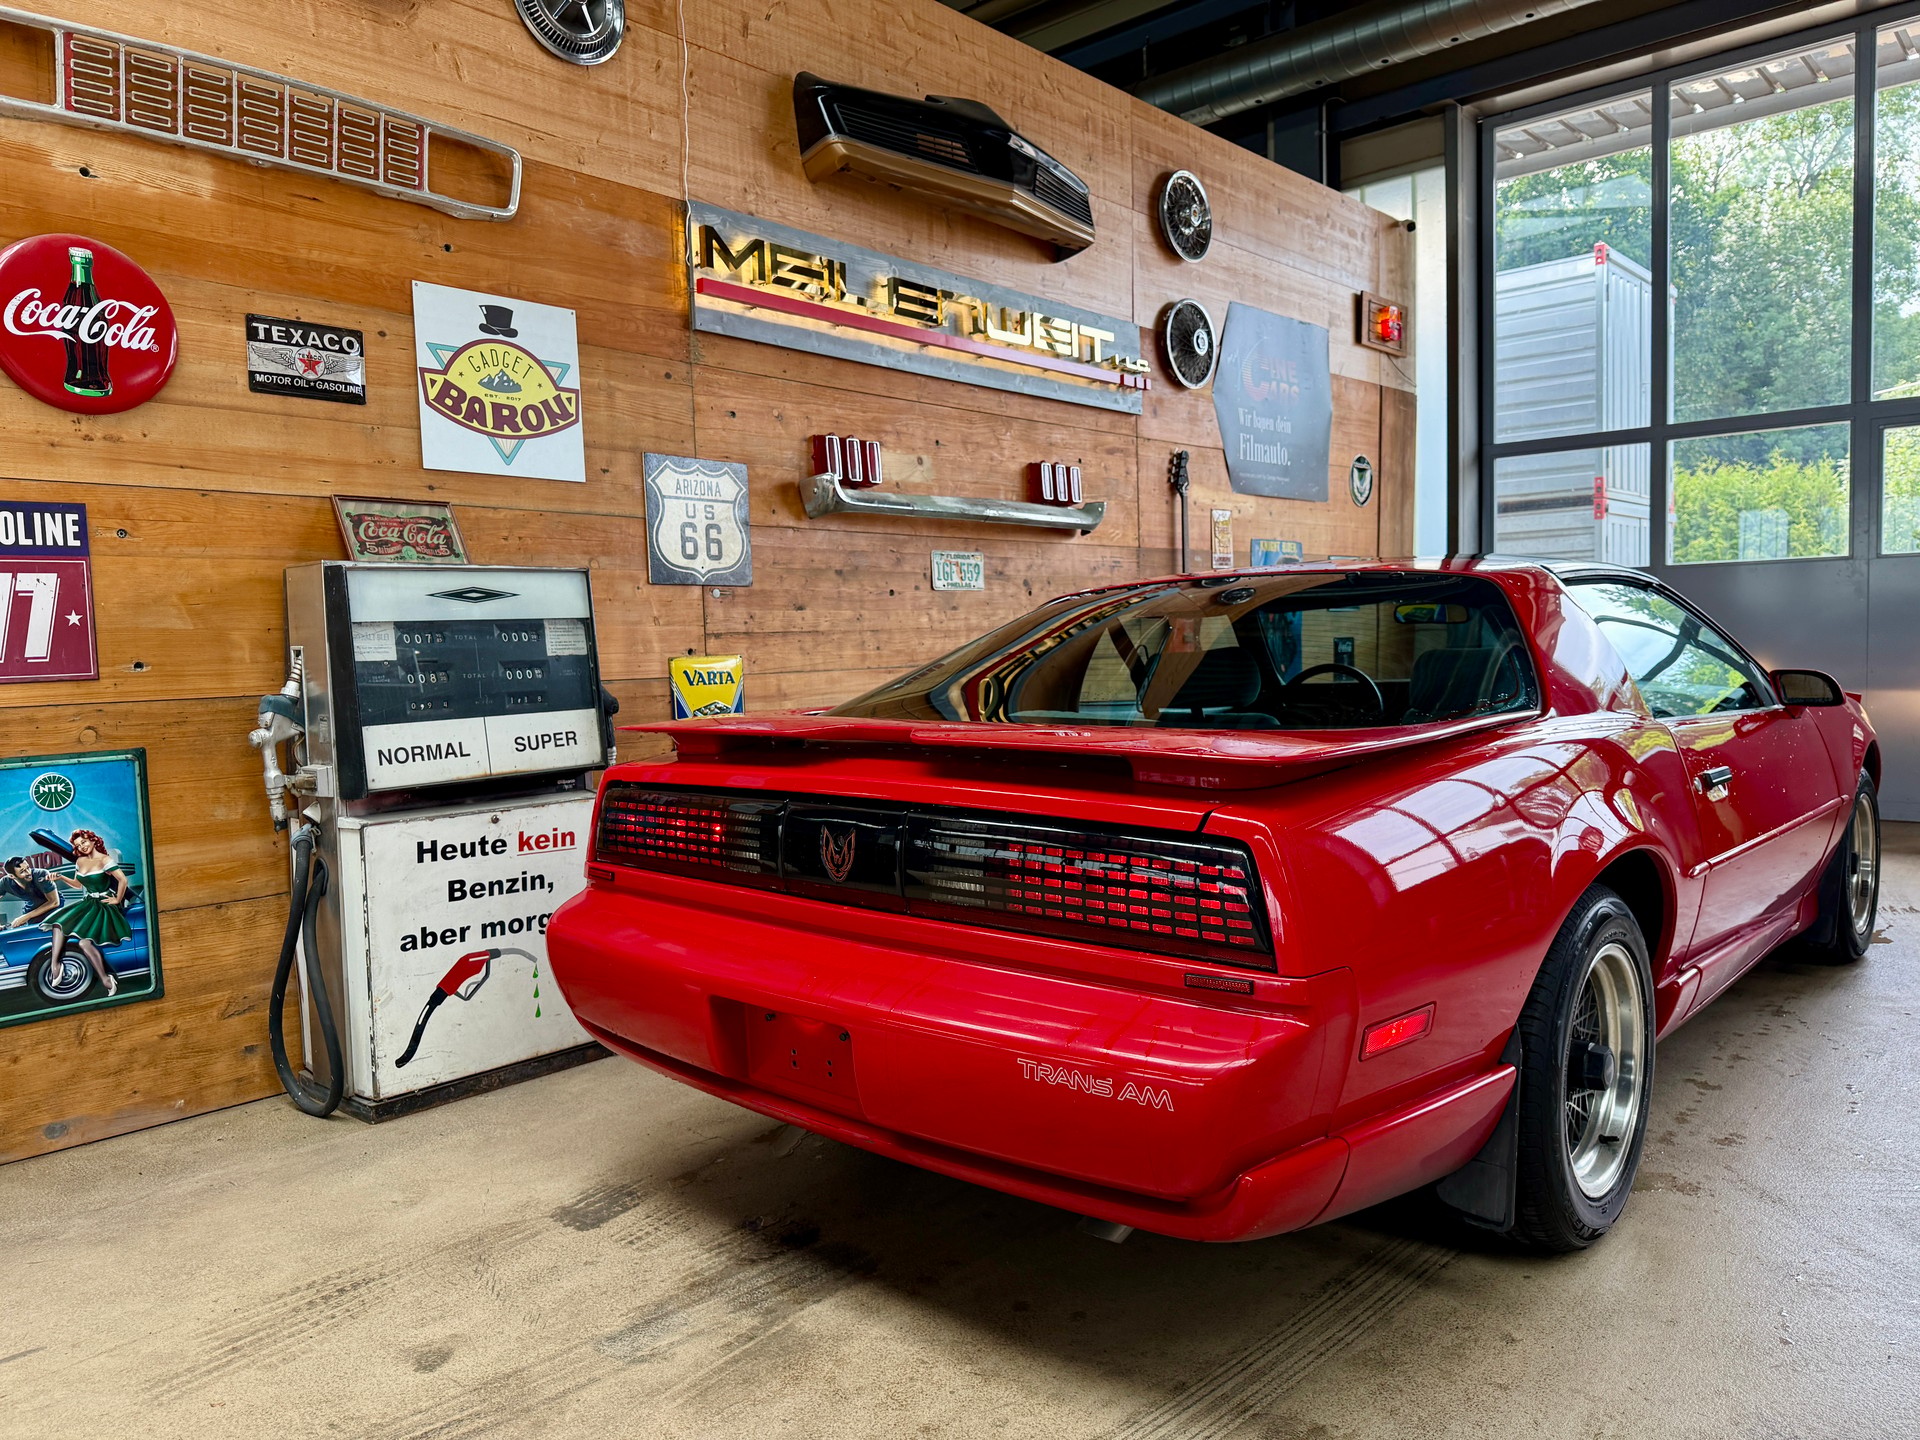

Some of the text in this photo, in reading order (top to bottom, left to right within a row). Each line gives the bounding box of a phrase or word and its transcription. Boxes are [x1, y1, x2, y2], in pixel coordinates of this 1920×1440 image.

[4, 288, 159, 351] Coca-Cola
[251, 322, 360, 354] TEXACO
[298, 352, 322, 361] TEXACO
[467, 348, 534, 379] GADGET
[255, 374, 362, 394] MOTOR OIL GASOLINE
[430, 378, 575, 433] BARON
[1238, 407, 1252, 427] Wir
[1276, 415, 1292, 434] dein
[1239, 433, 1292, 466] Filmauto.
[675, 478, 722, 497] ARIZONA
[680, 522, 723, 561] 66
[683, 669, 735, 686] VARTA
[377, 741, 471, 766] NORMAL
[514, 731, 578, 752] SUPER
[40, 783, 66, 793] NTK
[416, 827, 576, 864] Heute kein
[448, 870, 554, 902] Benzin,
[400, 925, 470, 952] aber
[1017, 1058, 1174, 1111] TRANS AM
